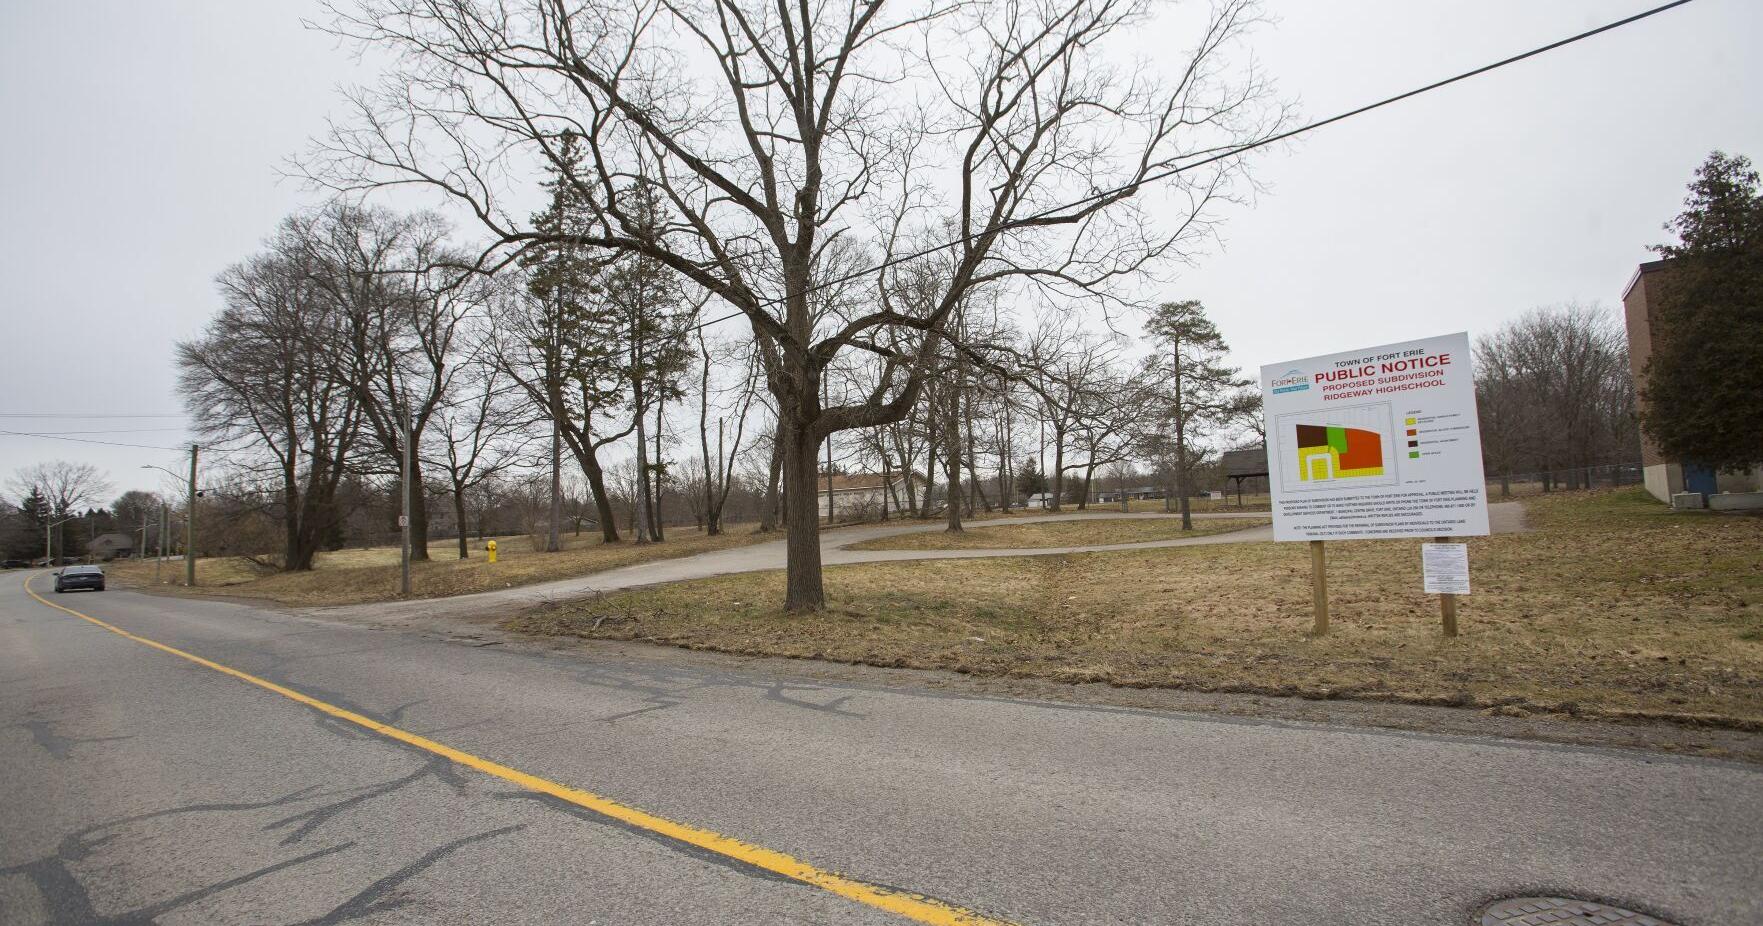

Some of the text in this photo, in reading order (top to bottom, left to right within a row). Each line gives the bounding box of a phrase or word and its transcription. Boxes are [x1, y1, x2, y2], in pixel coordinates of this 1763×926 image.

[1314, 353, 1451, 384] PUBLIC NOTICE
[1334, 348, 1425, 368] TOWN OF FORT ERIE
[1322, 379, 1375, 392] PROPOSED
[1378, 369, 1444, 385] SUBDIVISION
[1323, 388, 1373, 401] RIDGEWAY
[1375, 379, 1446, 395] HIGHSCHOOL
